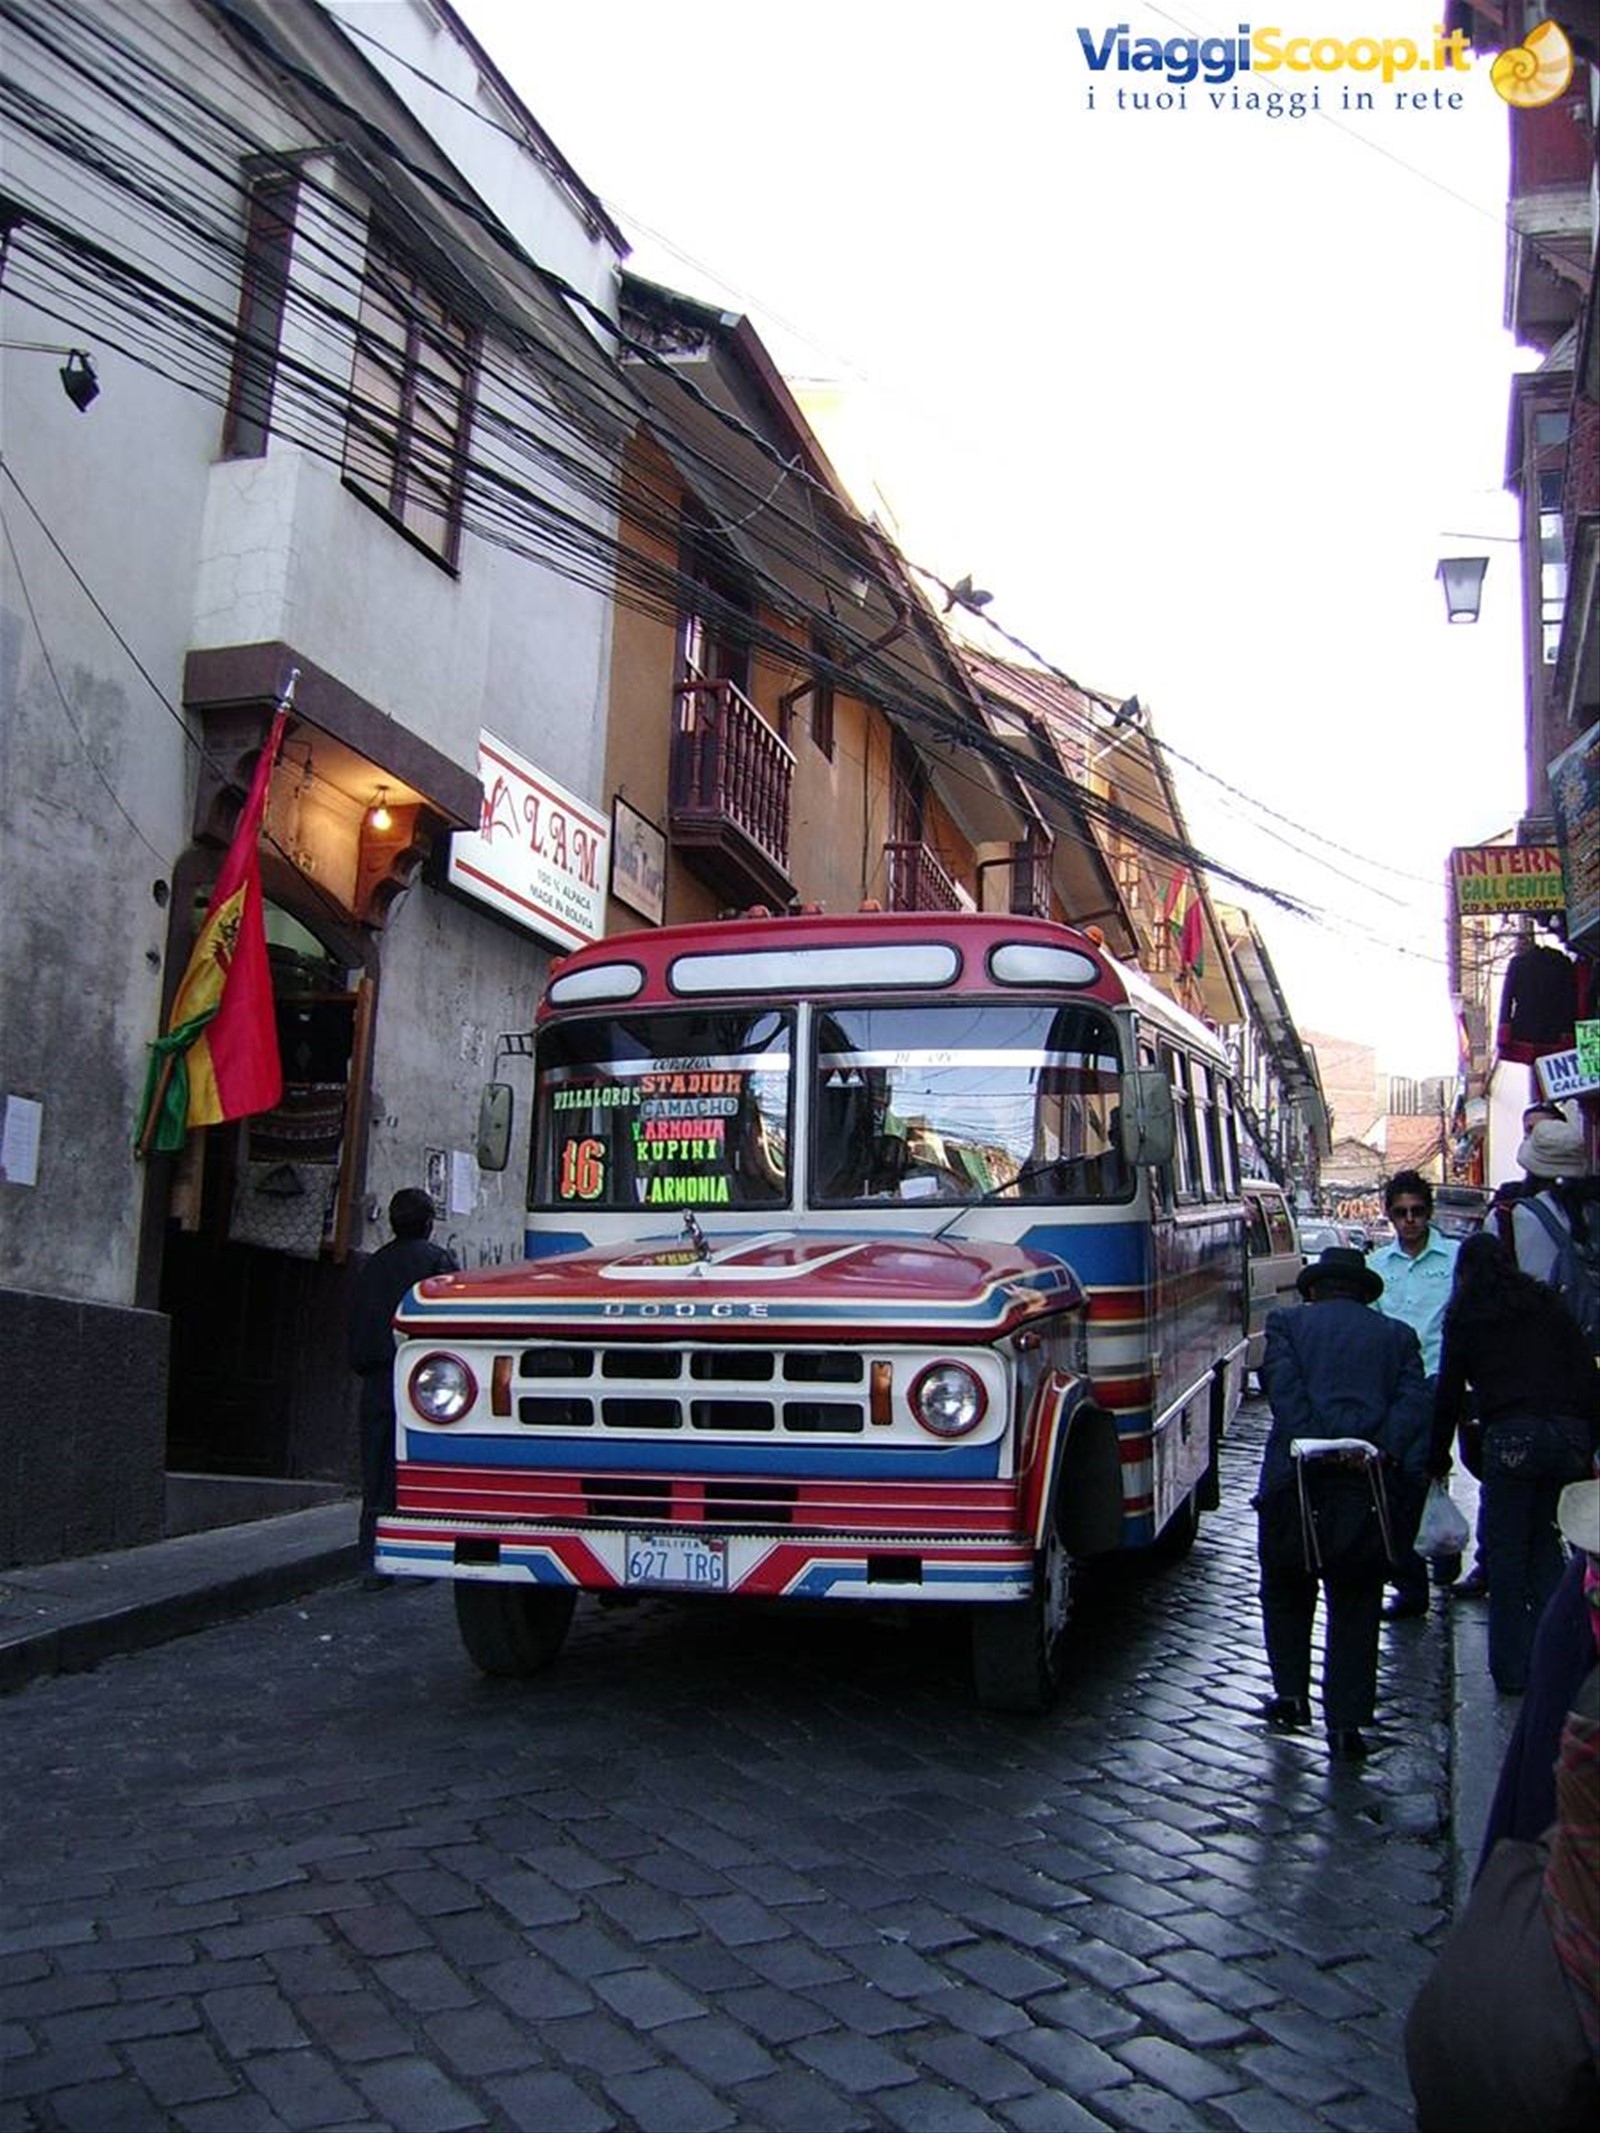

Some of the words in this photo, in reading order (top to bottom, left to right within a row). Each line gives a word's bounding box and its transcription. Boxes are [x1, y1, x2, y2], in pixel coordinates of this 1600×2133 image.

[562, 885, 591, 911] ALPACA
[1461, 877, 1501, 900] CALL
[529, 883, 553, 907] MADE
[555, 899, 564, 913] IN
[564, 903, 594, 931] BOLIVIA
[1496, 900, 1522, 911] DVD
[1524, 898, 1560, 911] COPY
[641, 1073, 742, 1094] STADIUM
[1552, 1077, 1587, 1093] CALL
[554, 1086, 641, 1110] VILLALOBOS
[641, 1098, 739, 1117] CAMACHO
[561, 1138, 606, 1199] 16
[602, 1302, 769, 1318] DODGE
[650, 1538, 700, 1549] BOLIVIA
[630, 1550, 669, 1579] 627
[683, 1552, 722, 1582] TRG
